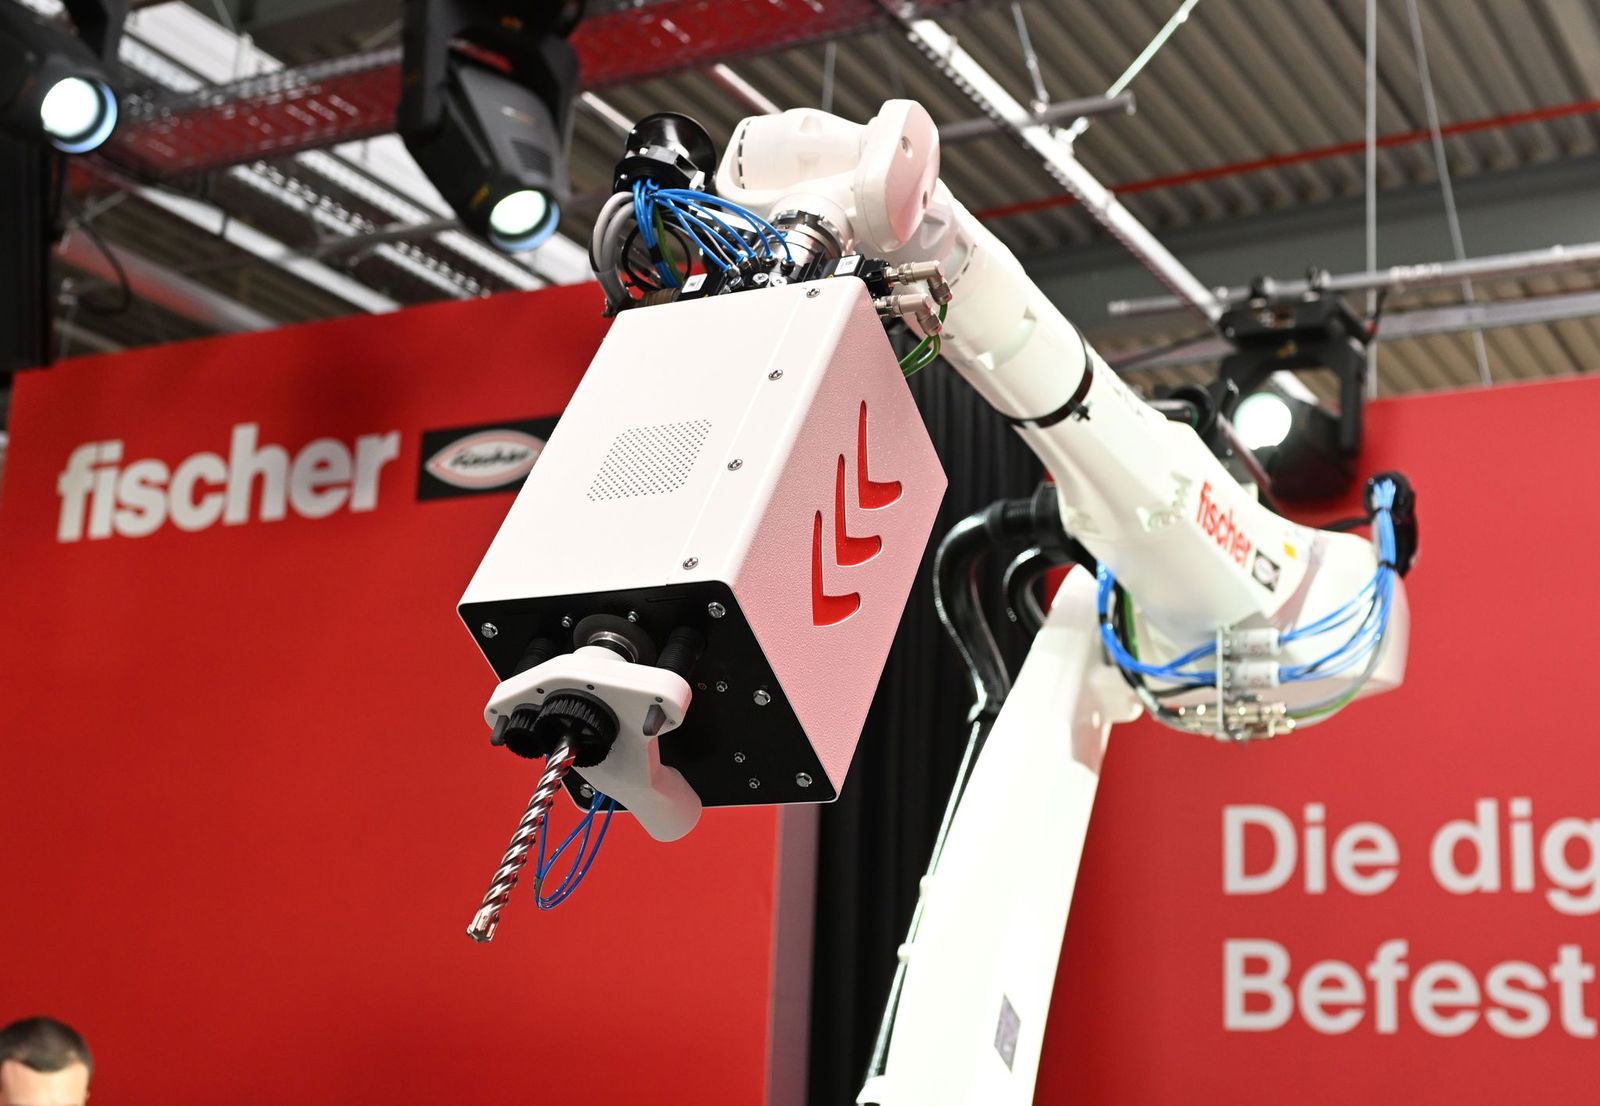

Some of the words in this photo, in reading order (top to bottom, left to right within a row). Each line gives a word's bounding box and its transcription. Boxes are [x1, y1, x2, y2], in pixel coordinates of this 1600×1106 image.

[57, 423, 400, 543] fischer
[1197, 480, 1252, 567] fischer
[1223, 803, 1400, 896] Die
[1430, 797, 1600, 916] dig
[1223, 939, 1598, 1039] Befest
